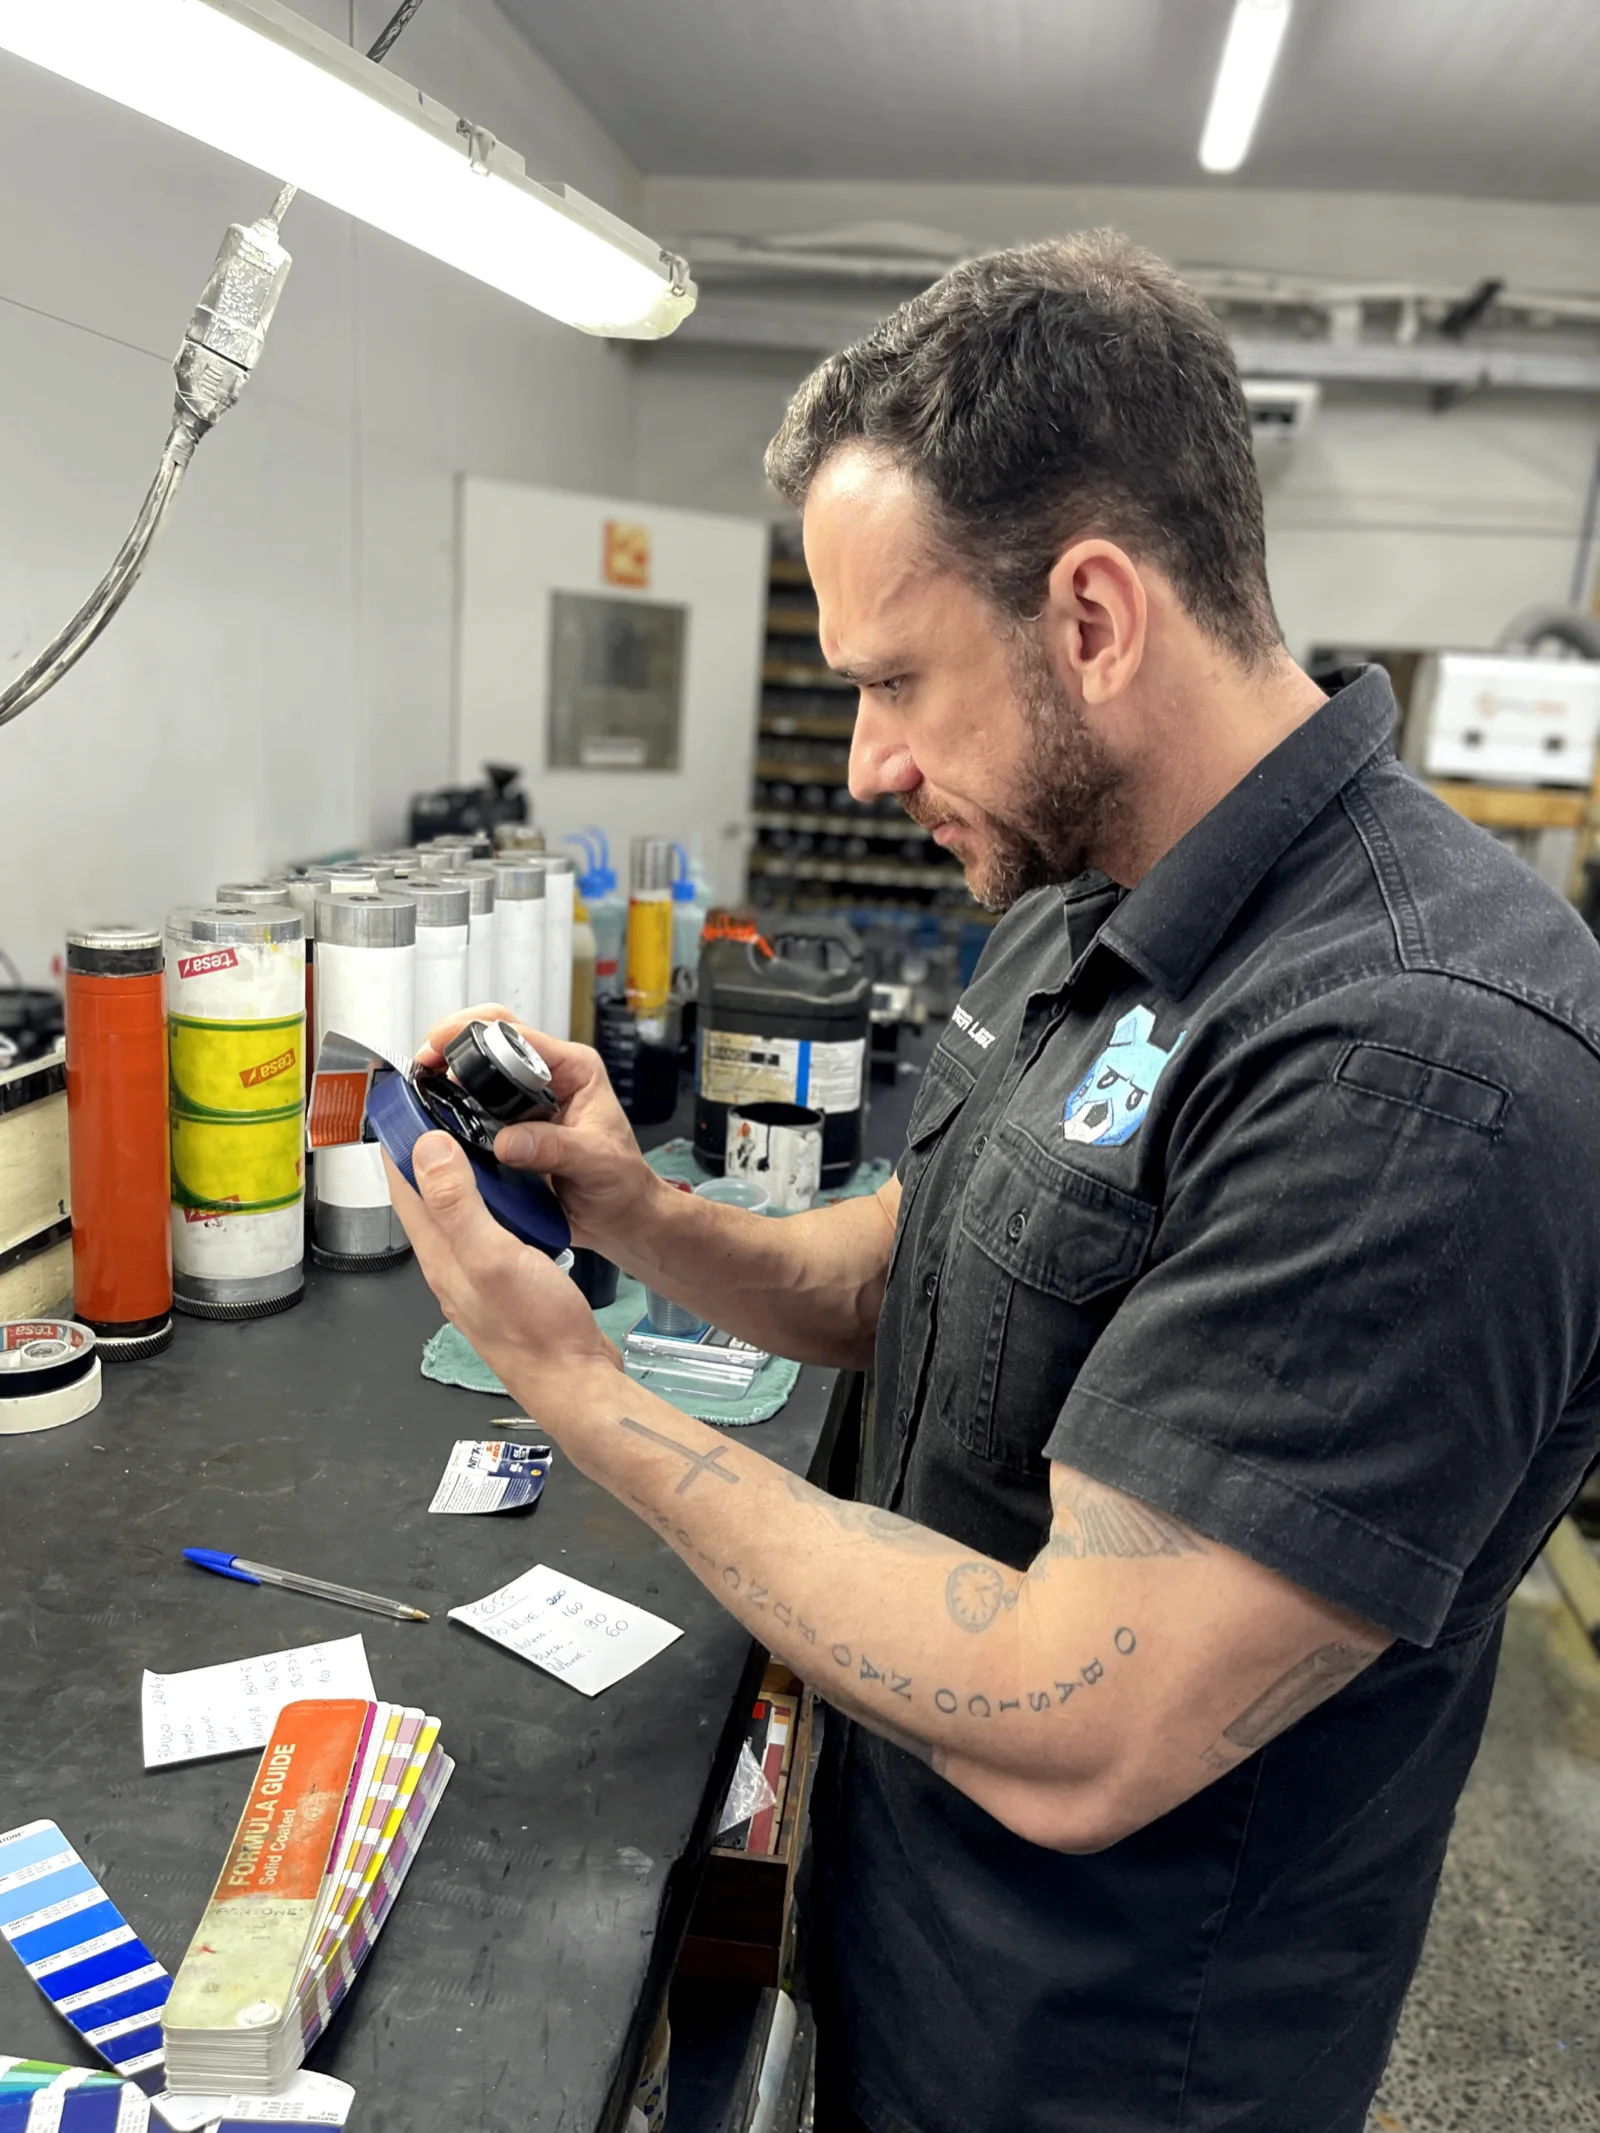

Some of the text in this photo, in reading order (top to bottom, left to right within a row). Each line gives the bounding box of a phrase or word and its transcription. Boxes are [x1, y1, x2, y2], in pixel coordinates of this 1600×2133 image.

[192, 951, 233, 972] tesa
[260, 1053, 294, 1078] tesa
[15, 1324, 54, 1336] tesa
[562, 1602, 583, 1617] 160
[605, 1620, 629, 1637] 60
[1114, 1627, 1136, 1655] O
[229, 1799, 277, 1887] FORMULA
[267, 1743, 296, 1795] GUIDE
[258, 1808, 297, 1886] Solid Coated
